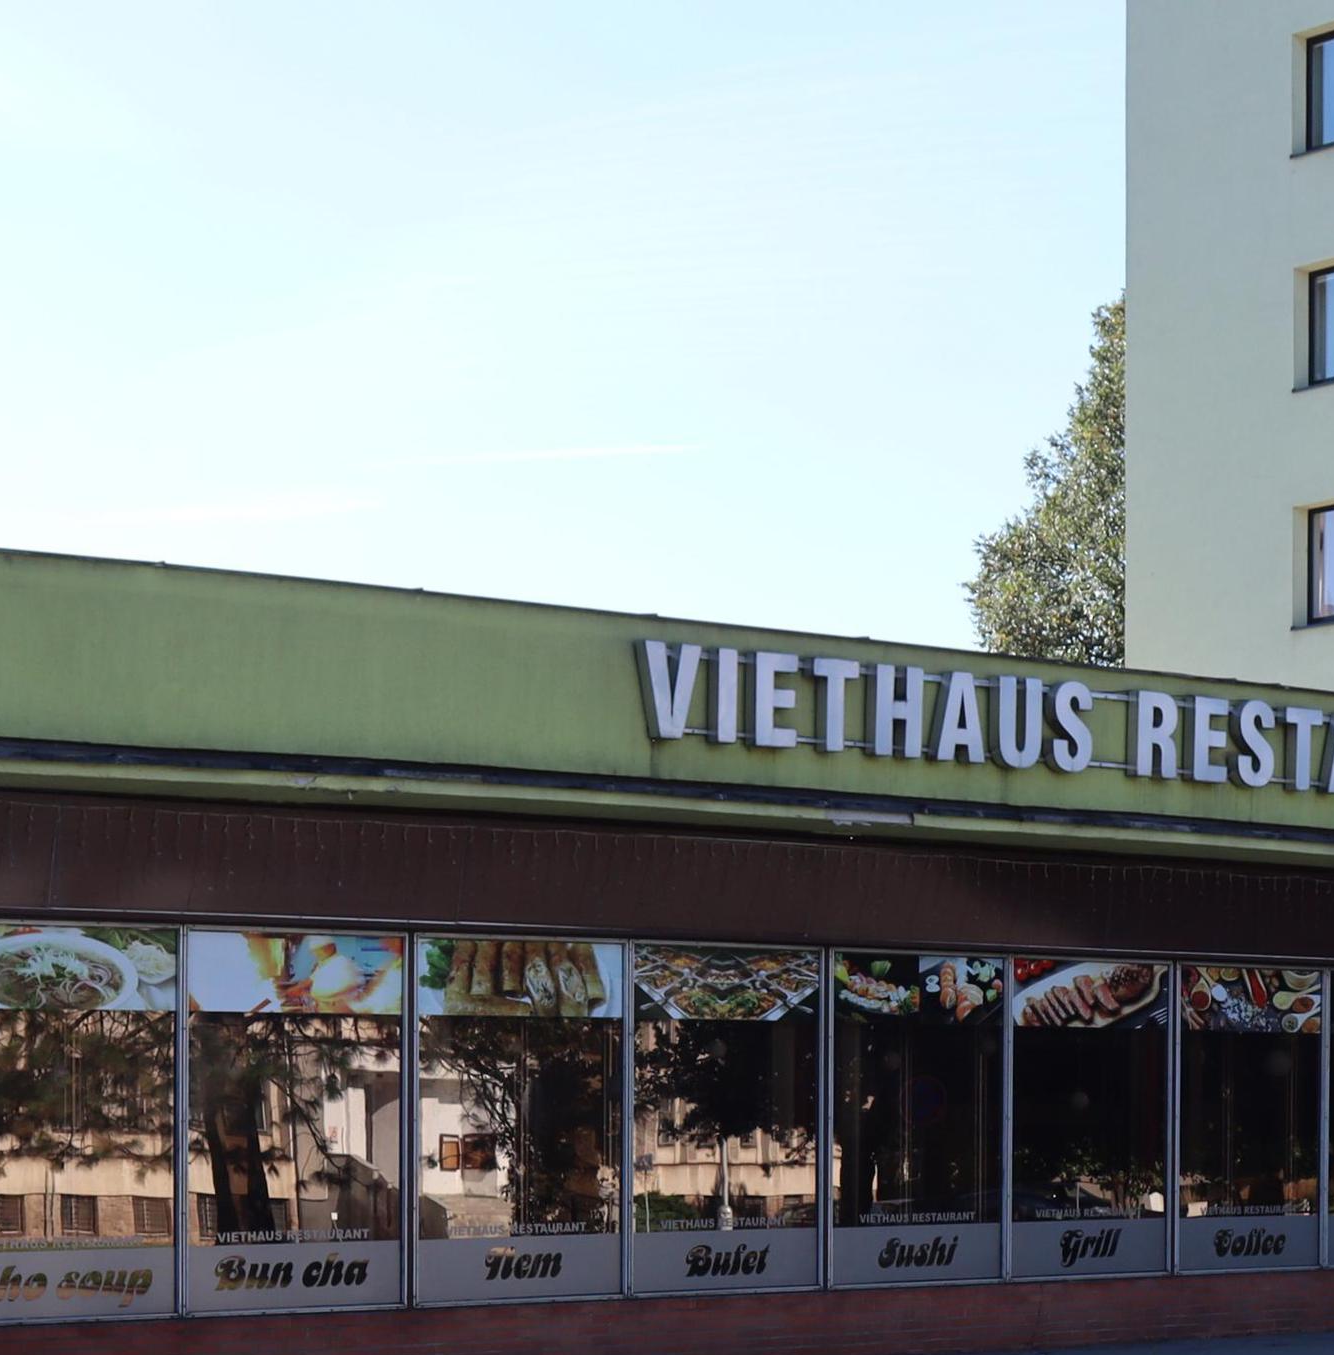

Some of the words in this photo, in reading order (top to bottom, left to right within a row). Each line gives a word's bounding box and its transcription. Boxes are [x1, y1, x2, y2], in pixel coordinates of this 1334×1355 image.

[636, 639, 1093, 772] VIETHAUS
[659, 1218, 715, 1230] VIETHAUS
[718, 1216, 787, 1228] ESTAURANT
[859, 1213, 909, 1224] VIETHAUS
[912, 1211, 976, 1222] RESTAURANT
[1035, 1207, 1081, 1219] VIETHAUS
[1244, 1203, 1297, 1215] RESTAURA
[217, 1231, 283, 1244] VIETHAUS
[286, 1228, 371, 1241] RESTAURANT
[511, 1222, 587, 1235] RESTAURANT
[1214, 1227, 1286, 1257] Coffee
[685, 1243, 771, 1277] Bufet
[878, 1235, 959, 1268] Sushi
[1060, 1228, 1123, 1268] Grill
[214, 1255, 294, 1291] Bun
[302, 1252, 370, 1287] cha
[56, 1268, 153, 1308] soup
